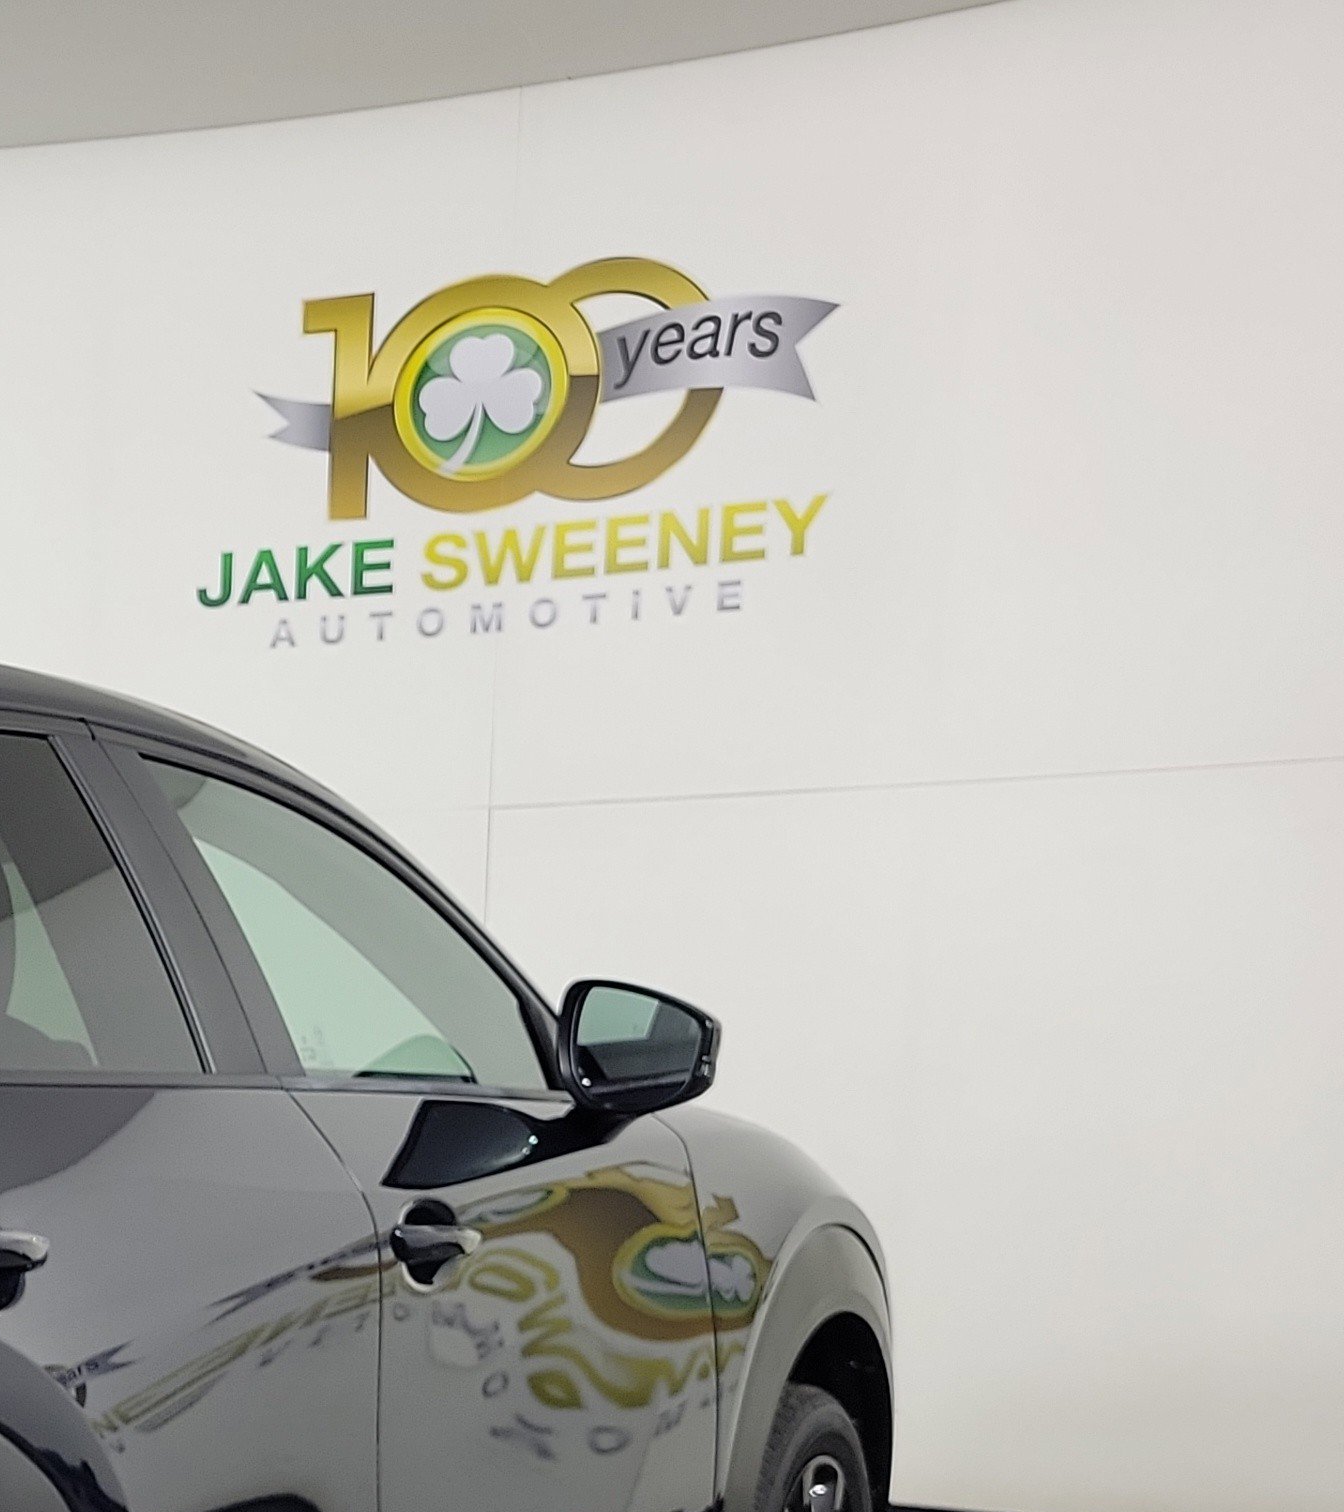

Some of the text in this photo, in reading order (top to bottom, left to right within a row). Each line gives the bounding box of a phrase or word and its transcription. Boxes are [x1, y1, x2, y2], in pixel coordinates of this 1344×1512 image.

[301, 256, 784, 521] 100 years
[196, 491, 830, 610] JAKE SWEENEY
[269, 580, 743, 650] AUTOMOTIVE
